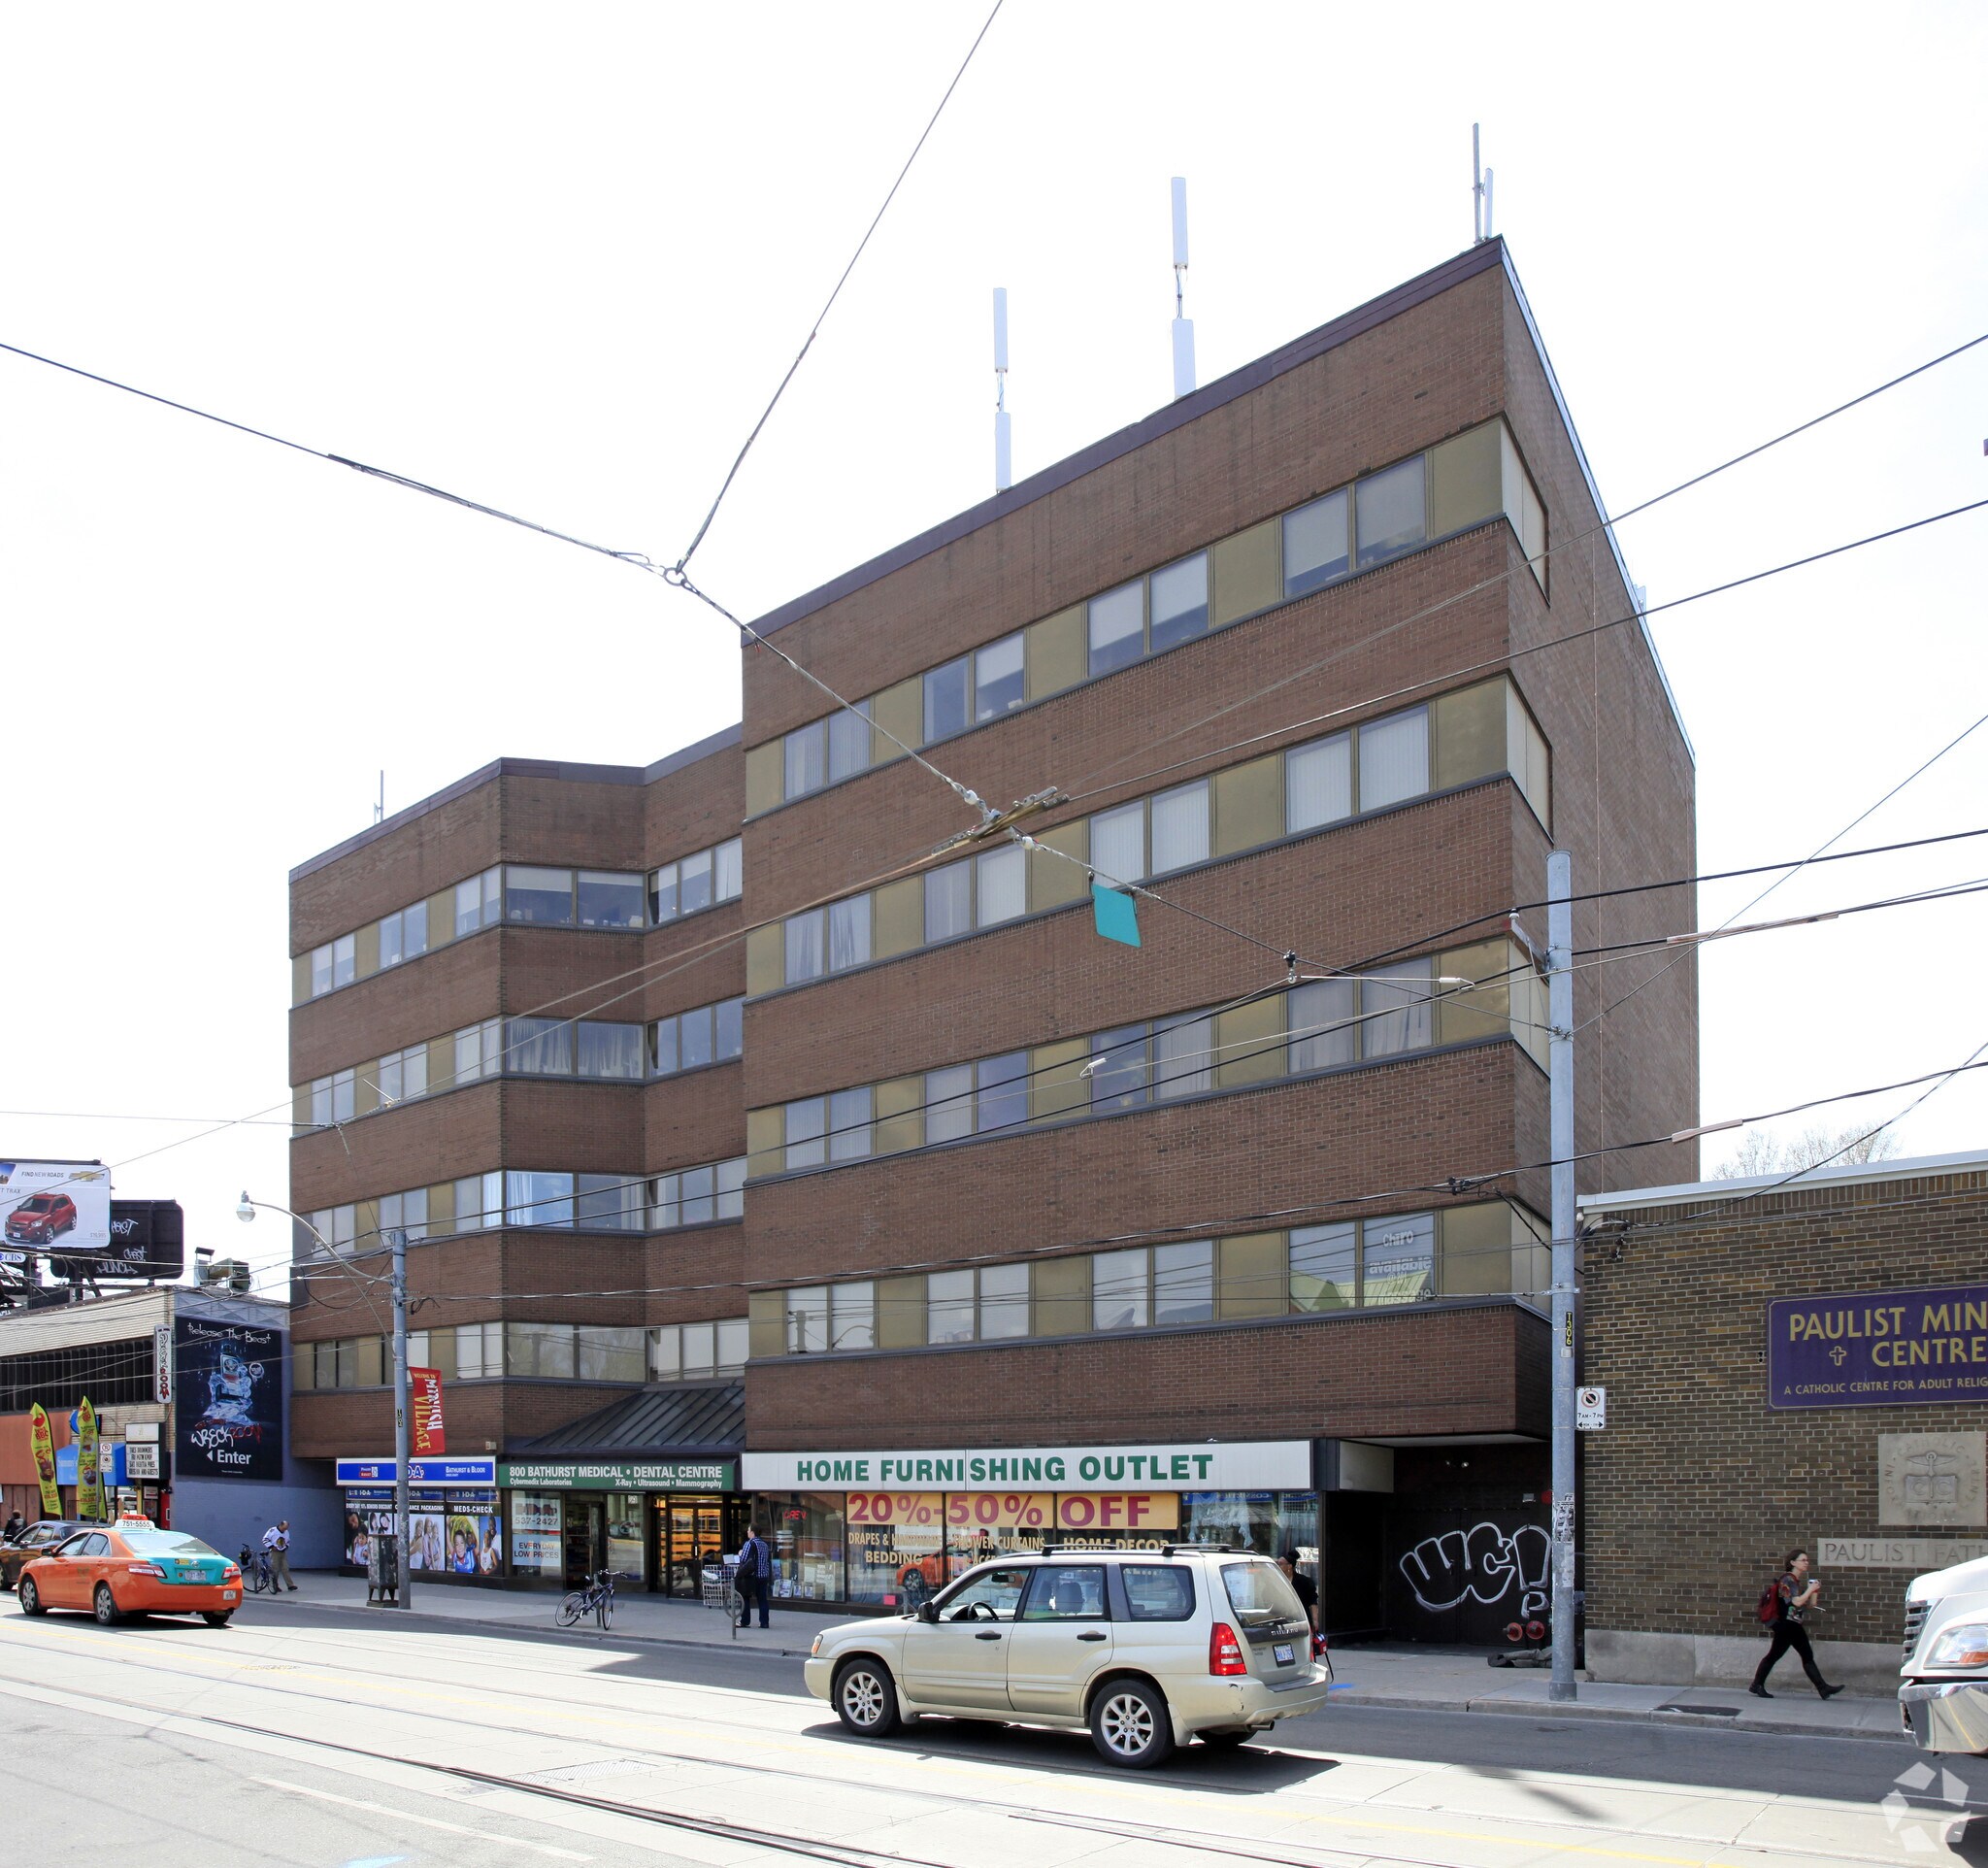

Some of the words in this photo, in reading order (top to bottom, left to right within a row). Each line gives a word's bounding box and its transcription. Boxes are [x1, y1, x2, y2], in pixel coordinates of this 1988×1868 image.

[1382, 1230, 1413, 1248] Chiro
[1369, 1256, 1432, 1275] available
[1789, 1307, 1905, 1342] PAULIST
[1921, 1301, 1988, 1334] MIN
[187, 1322, 223, 1338] Release
[225, 1328, 242, 1341] The
[245, 1330, 272, 1344] Beast
[1872, 1336, 1987, 1367] CENTRE
[1784, 1385, 1792, 1395] A
[1795, 1383, 1845, 1394] CATHOLIC
[1849, 1381, 1890, 1392] CENTRE
[1893, 1380, 1914, 1390] FOR
[1918, 1378, 1953, 1389] ADULT
[191, 1426, 233, 1449] WRECK
[216, 1450, 251, 1464] Enter
[510, 1466, 526, 1478] 800
[527, 1466, 577, 1478] BATHURST
[578, 1466, 623, 1478] MEDICAL
[633, 1466, 676, 1478] DENTAL
[678, 1466, 722, 1478] CENTRE
[797, 1459, 870, 1482] HOME
[880, 1456, 1066, 1482] FURNISHING
[1078, 1454, 1213, 1481] OUTLET
[510, 1478, 540, 1486] Cybermedix
[615, 1479, 632, 1487] X-Ray
[676, 1479, 722, 1488] Mammography
[453, 1505, 493, 1514] MEDS-CHECK
[1060, 1495, 1151, 1527] OFF
[514, 1517, 558, 1525] 537-2427
[518, 1542, 555, 1551] EVERYDAY
[848, 1532, 880, 1546] DRAPES
[882, 1534, 889, 1546] &
[953, 1535, 995, 1550] SHOWER
[997, 1536, 1045, 1551] CURTAINS
[1063, 1537, 1111, 1551] HOME
[533, 1551, 559, 1559] PRICES
[865, 1551, 922, 1565] BEDDING
[1824, 1543, 1921, 1562] PAULIST
